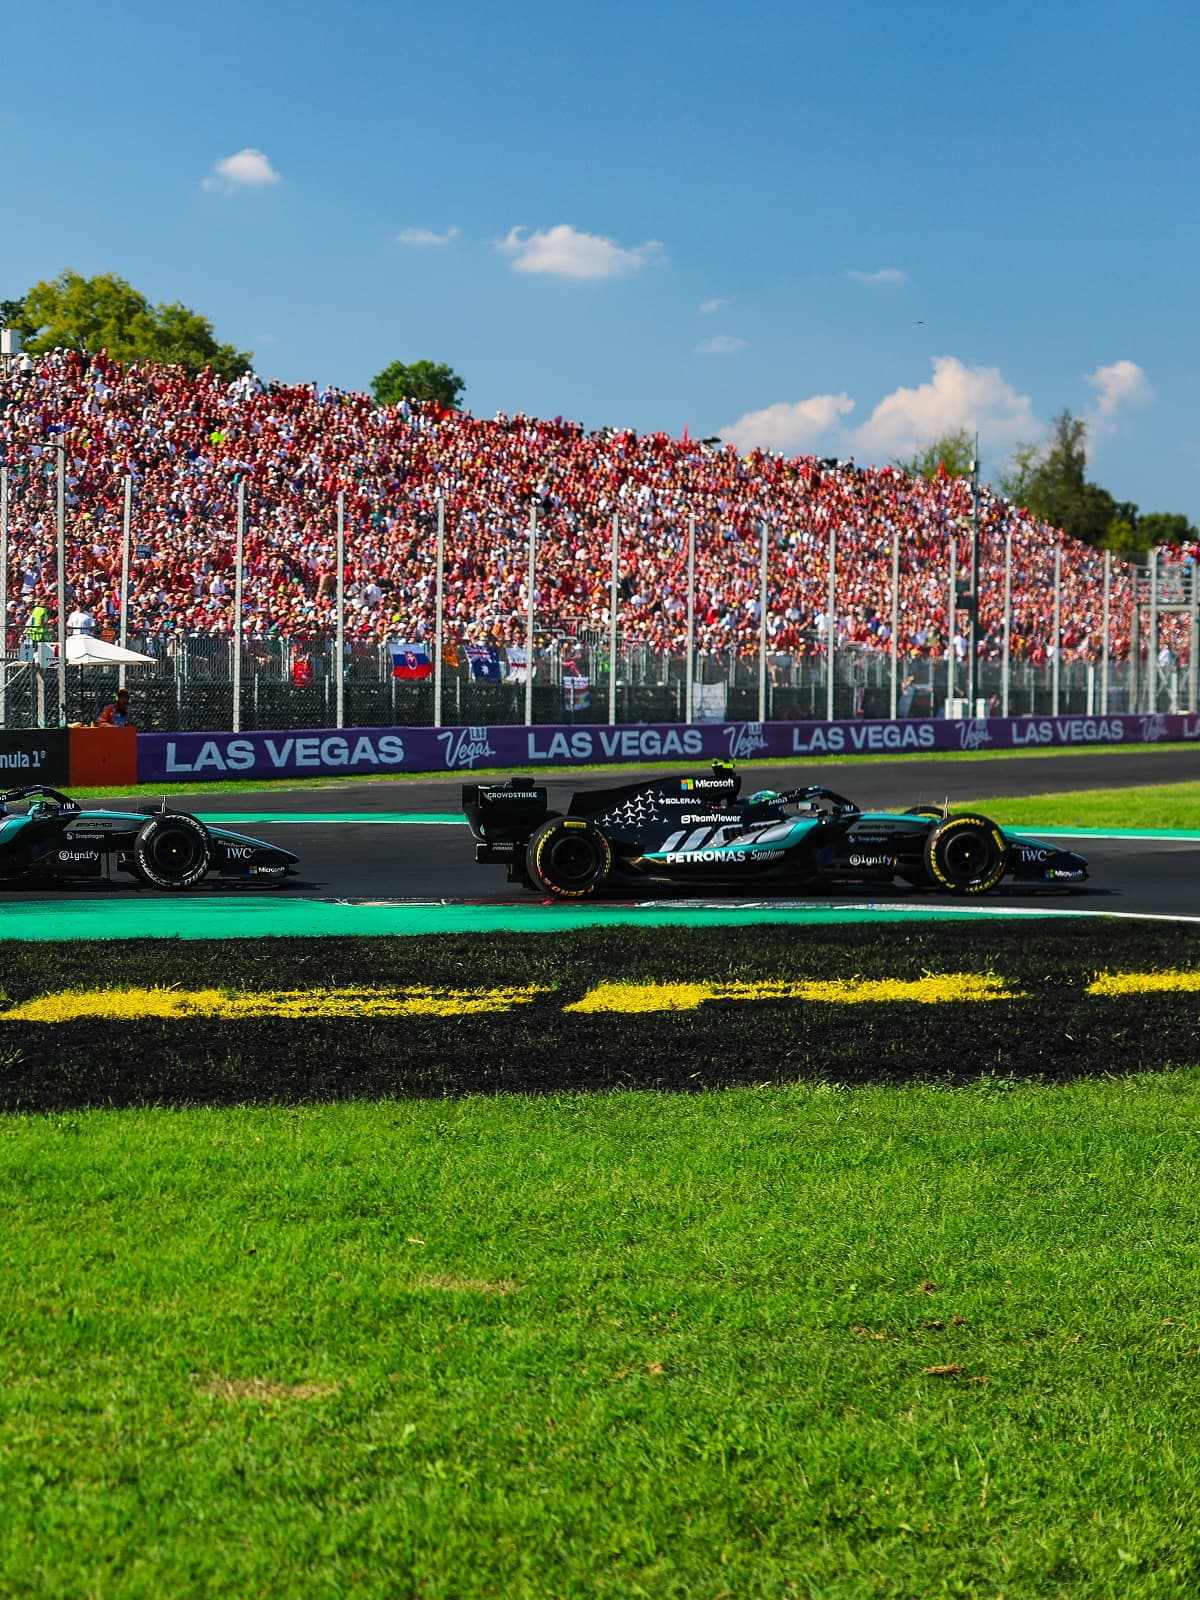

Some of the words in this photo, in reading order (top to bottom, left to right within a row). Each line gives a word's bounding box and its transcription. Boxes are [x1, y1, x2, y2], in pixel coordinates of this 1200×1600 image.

[793, 728, 844, 752] LAS
[849, 725, 934, 748] VEGAS
[1012, 722, 1053, 744] LAS
[1056, 720, 1124, 740] VEGAS
[437, 729, 496, 768] Vegas
[528, 731, 592, 759] LAS
[599, 730, 703, 756] VEGAS
[166, 740, 255, 772] LAS
[264, 736, 405, 768] VEGAS
[695, 779, 734, 788] Microsoft
[487, 791, 538, 799] CROWDSTRIKE
[691, 814, 741, 823] TeamViewer
[226, 848, 252, 859] IWC
[666, 850, 746, 864] PETRONAS
[1021, 850, 1048, 862] IWC
